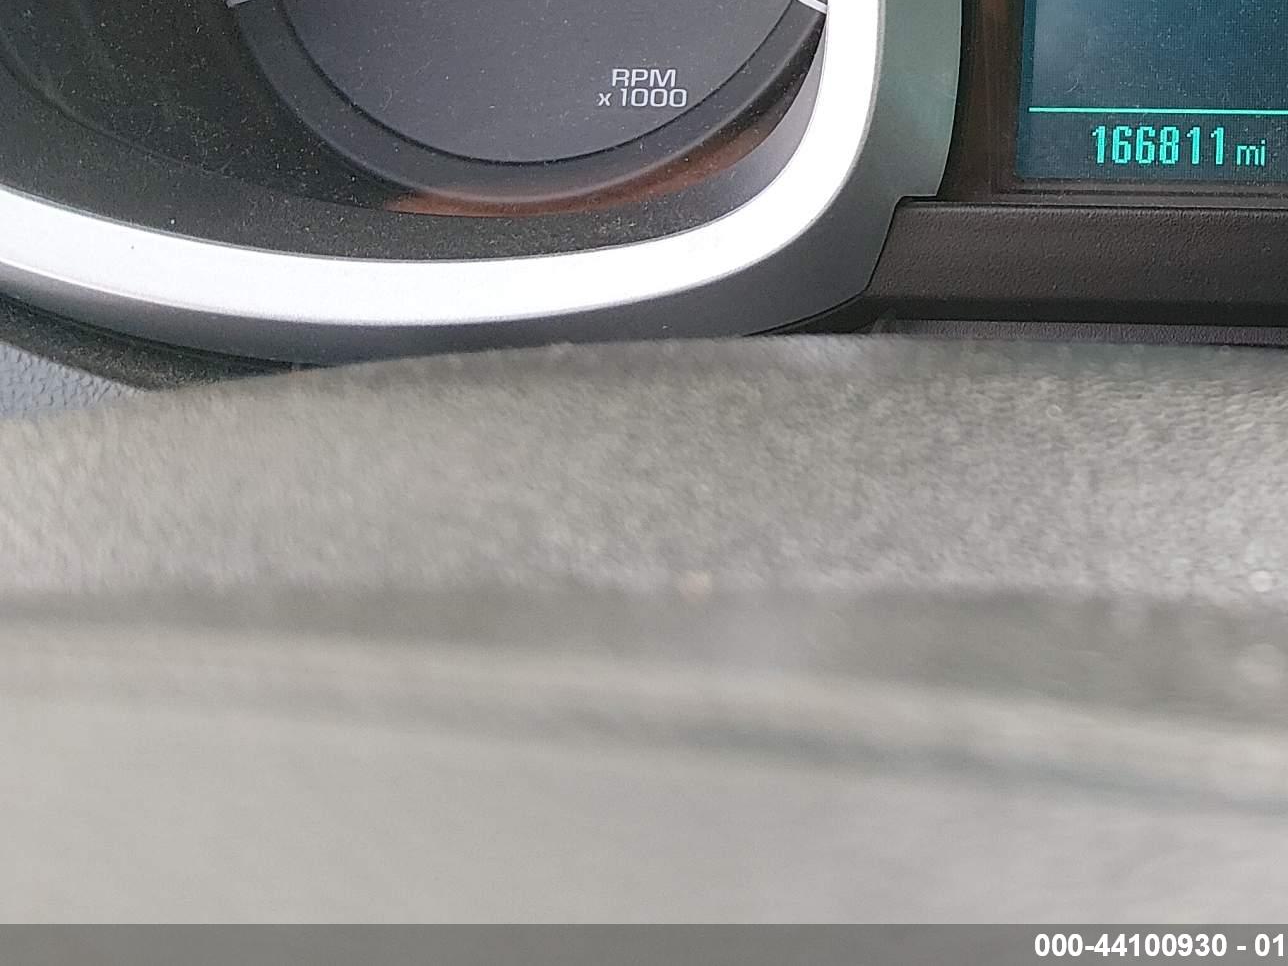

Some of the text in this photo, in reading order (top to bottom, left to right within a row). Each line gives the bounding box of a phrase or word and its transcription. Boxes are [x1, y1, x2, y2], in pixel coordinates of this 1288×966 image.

[611, 69, 676, 87] RPM
[1092, 125, 1267, 167] 166811 mi
